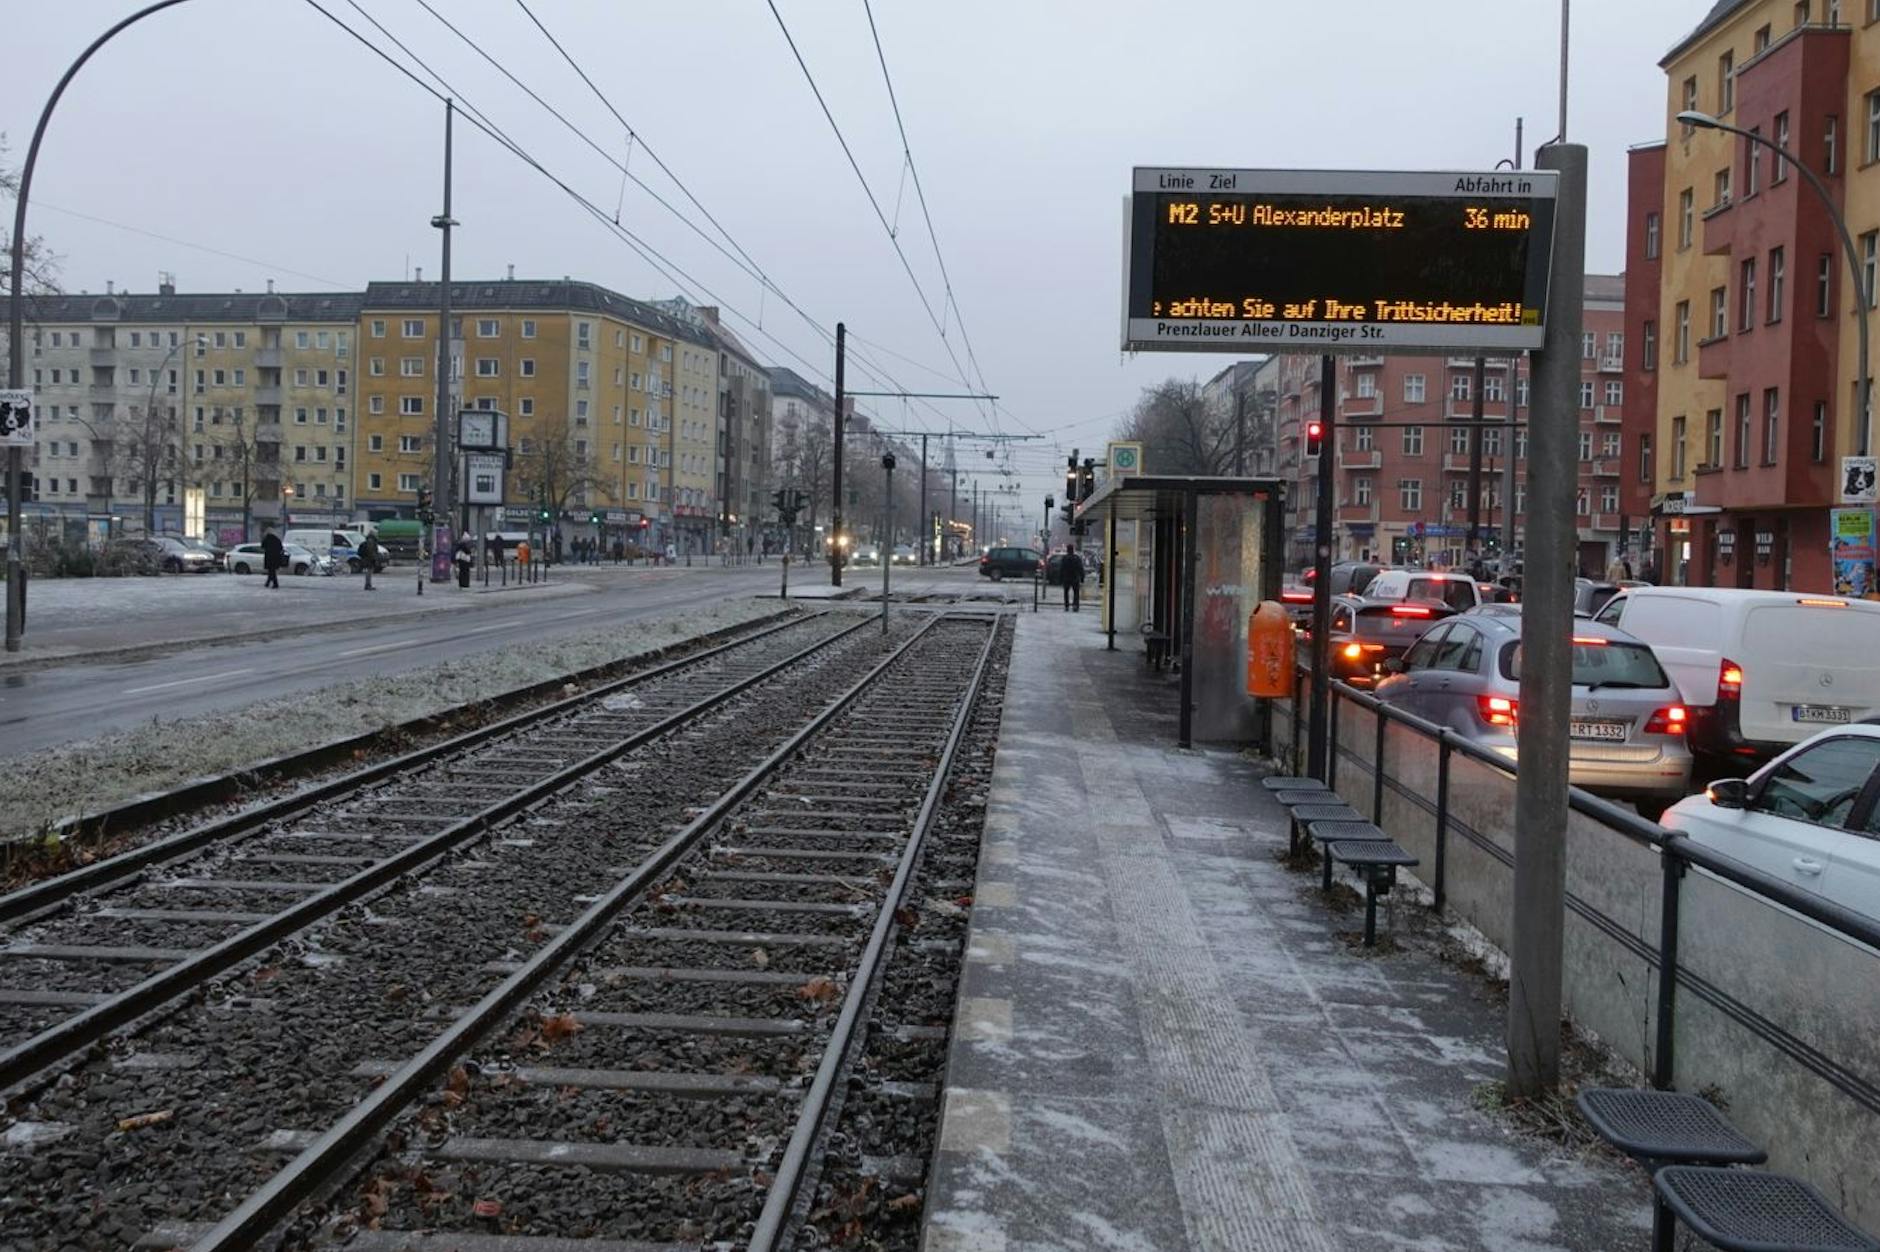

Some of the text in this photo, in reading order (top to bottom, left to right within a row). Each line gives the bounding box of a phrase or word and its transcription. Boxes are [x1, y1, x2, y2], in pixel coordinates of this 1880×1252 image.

[1159, 174, 1236, 189] Linie Ziel
[1454, 178, 1532, 193] Abfahrt in
[1168, 203, 1530, 229] M2 S+U Alexanderplatz 36 min
[1169, 297, 1236, 318] achten
[1242, 298, 1275, 318] Sie
[1283, 299, 1318, 319] auf
[1324, 299, 1367, 320] Ihre
[1374, 300, 1522, 322] Trittsicherheit!
[1157, 322, 1385, 341] Prenzlauer Allee/ Danziger Str.
[1579, 724, 1623, 738] RT 1332
